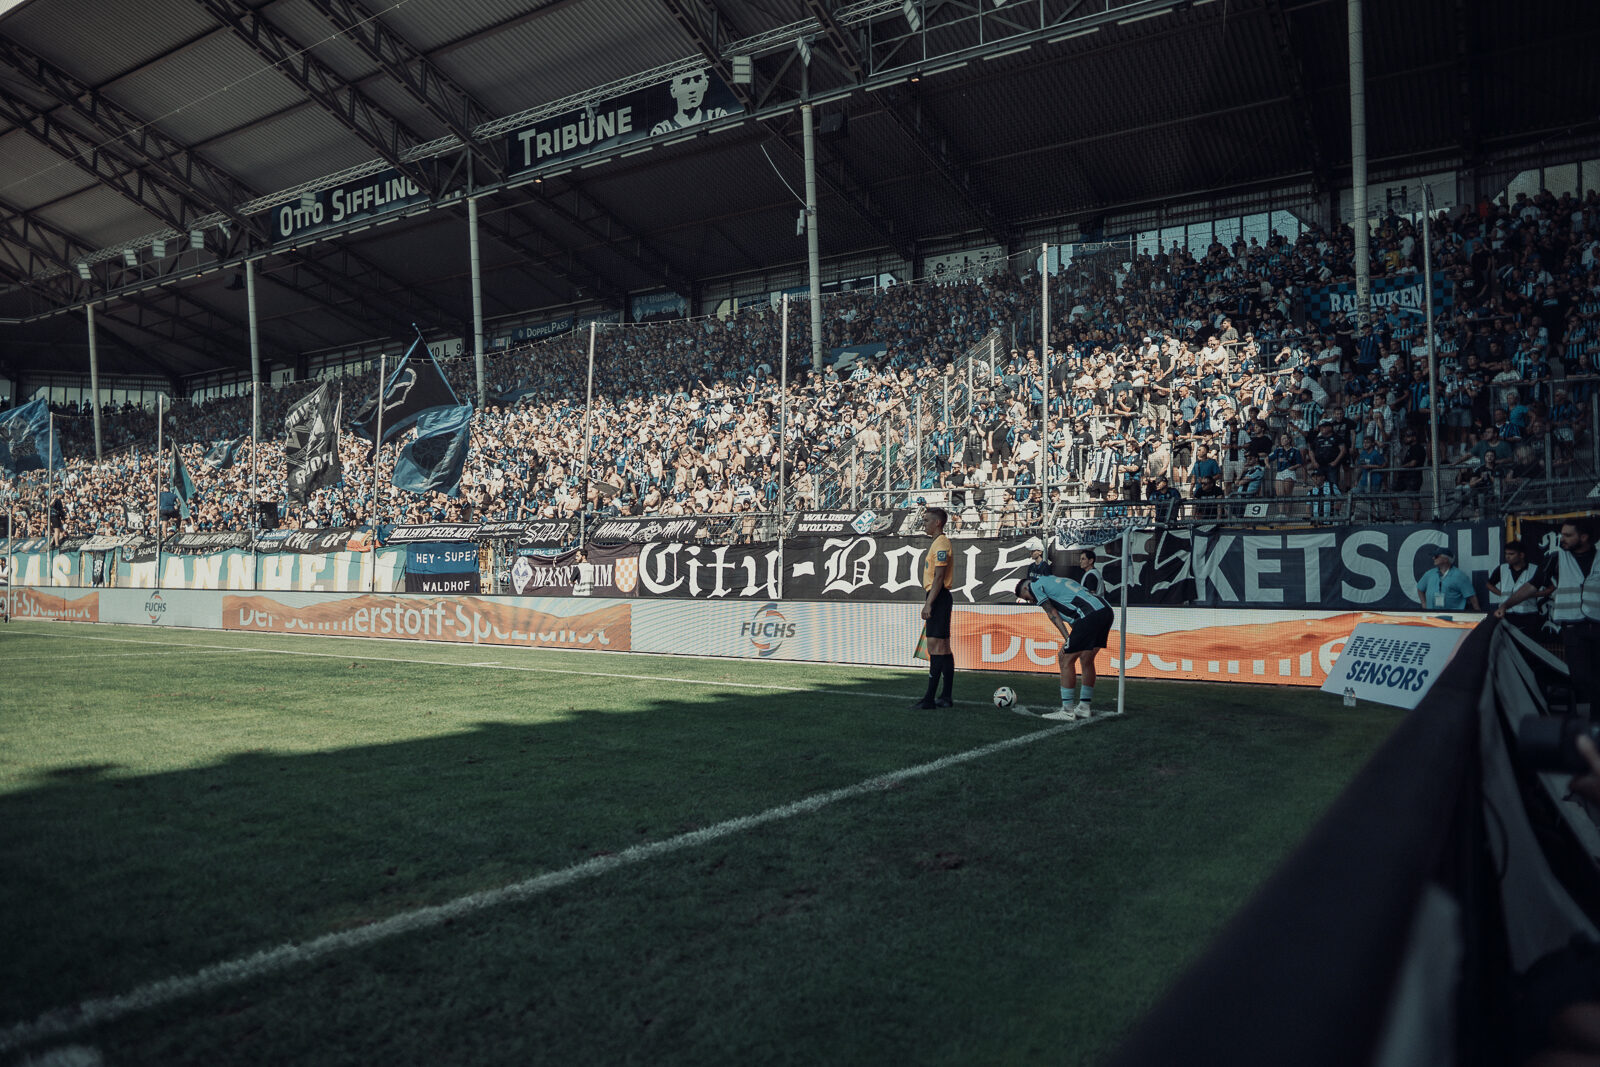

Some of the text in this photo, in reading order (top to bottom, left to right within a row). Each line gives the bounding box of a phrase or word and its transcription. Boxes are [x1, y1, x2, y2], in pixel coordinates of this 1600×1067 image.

[518, 105, 633, 167] TRIBÜNE
[1329, 283, 1424, 312] RAAUKEN
[803, 513, 857, 522] WALDHOF
[1251, 505, 1261, 515] 9
[797, 523, 844, 532] WOLVES
[416, 553, 435, 564] HEY
[444, 550, 477, 562] SUPER
[1191, 525, 1501, 604] KETSCH
[532, 564, 613, 587] MANNIM
[422, 581, 470, 592] WALDHOF
[144, 602, 167, 612] FUCHS
[740, 622, 796, 639] FUCHS
[1346, 660, 1429, 692] SENSORS
